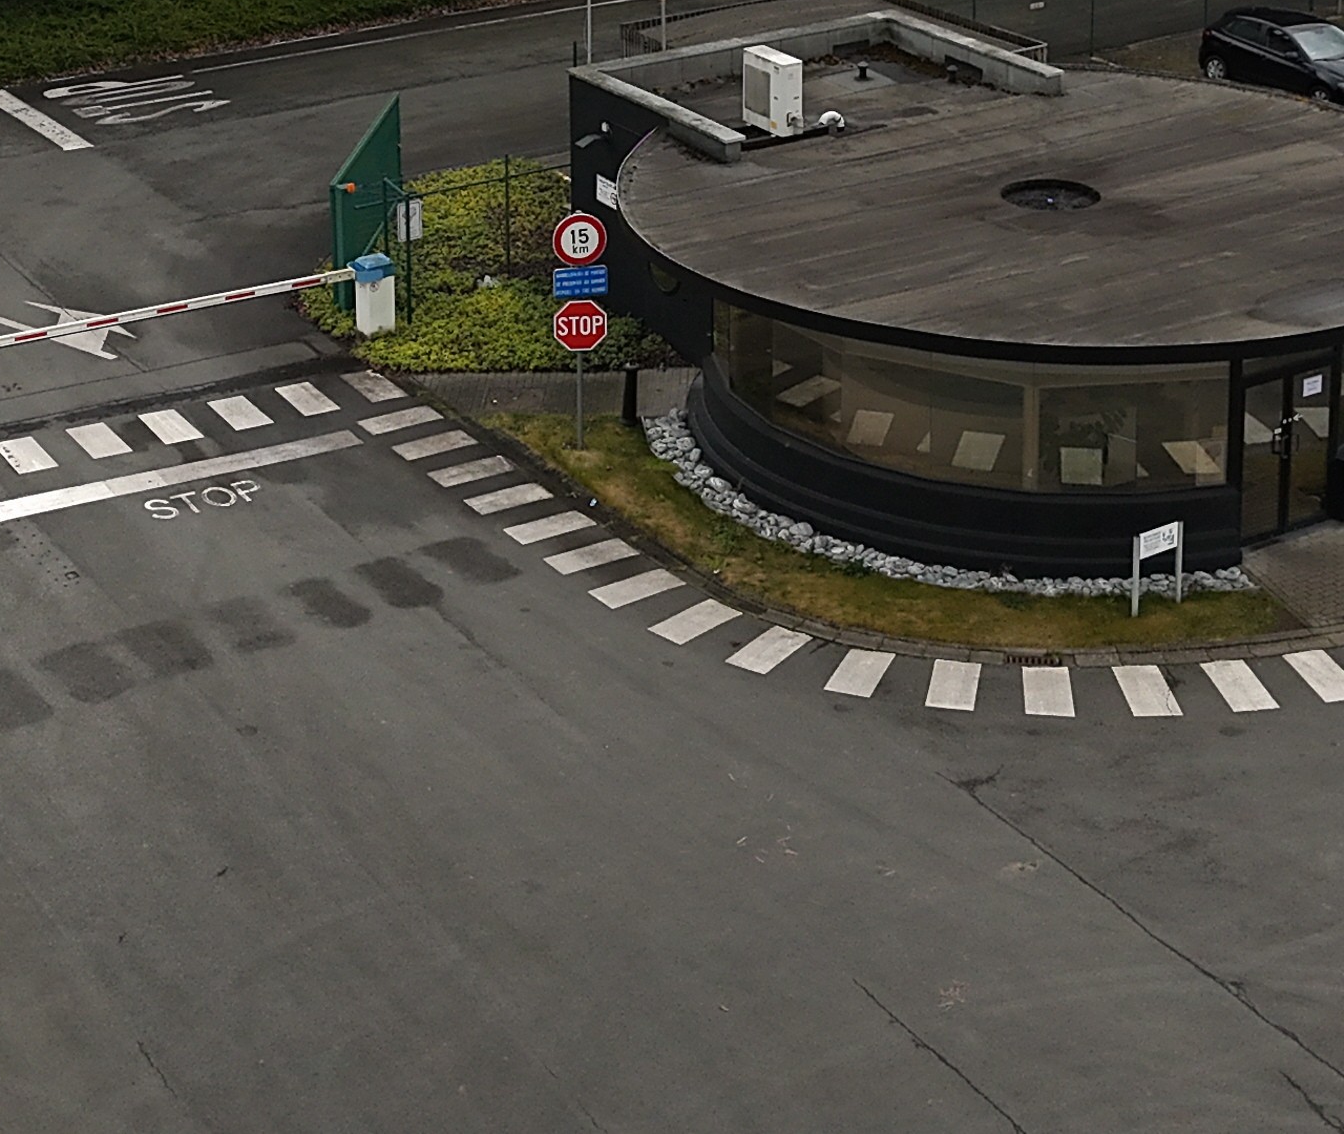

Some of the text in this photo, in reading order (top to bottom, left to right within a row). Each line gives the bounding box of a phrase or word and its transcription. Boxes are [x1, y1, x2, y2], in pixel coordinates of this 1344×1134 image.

[570, 228, 589, 244] 15
[572, 245, 589, 254] km
[558, 315, 604, 336] STOP
[144, 480, 261, 520] STOP
